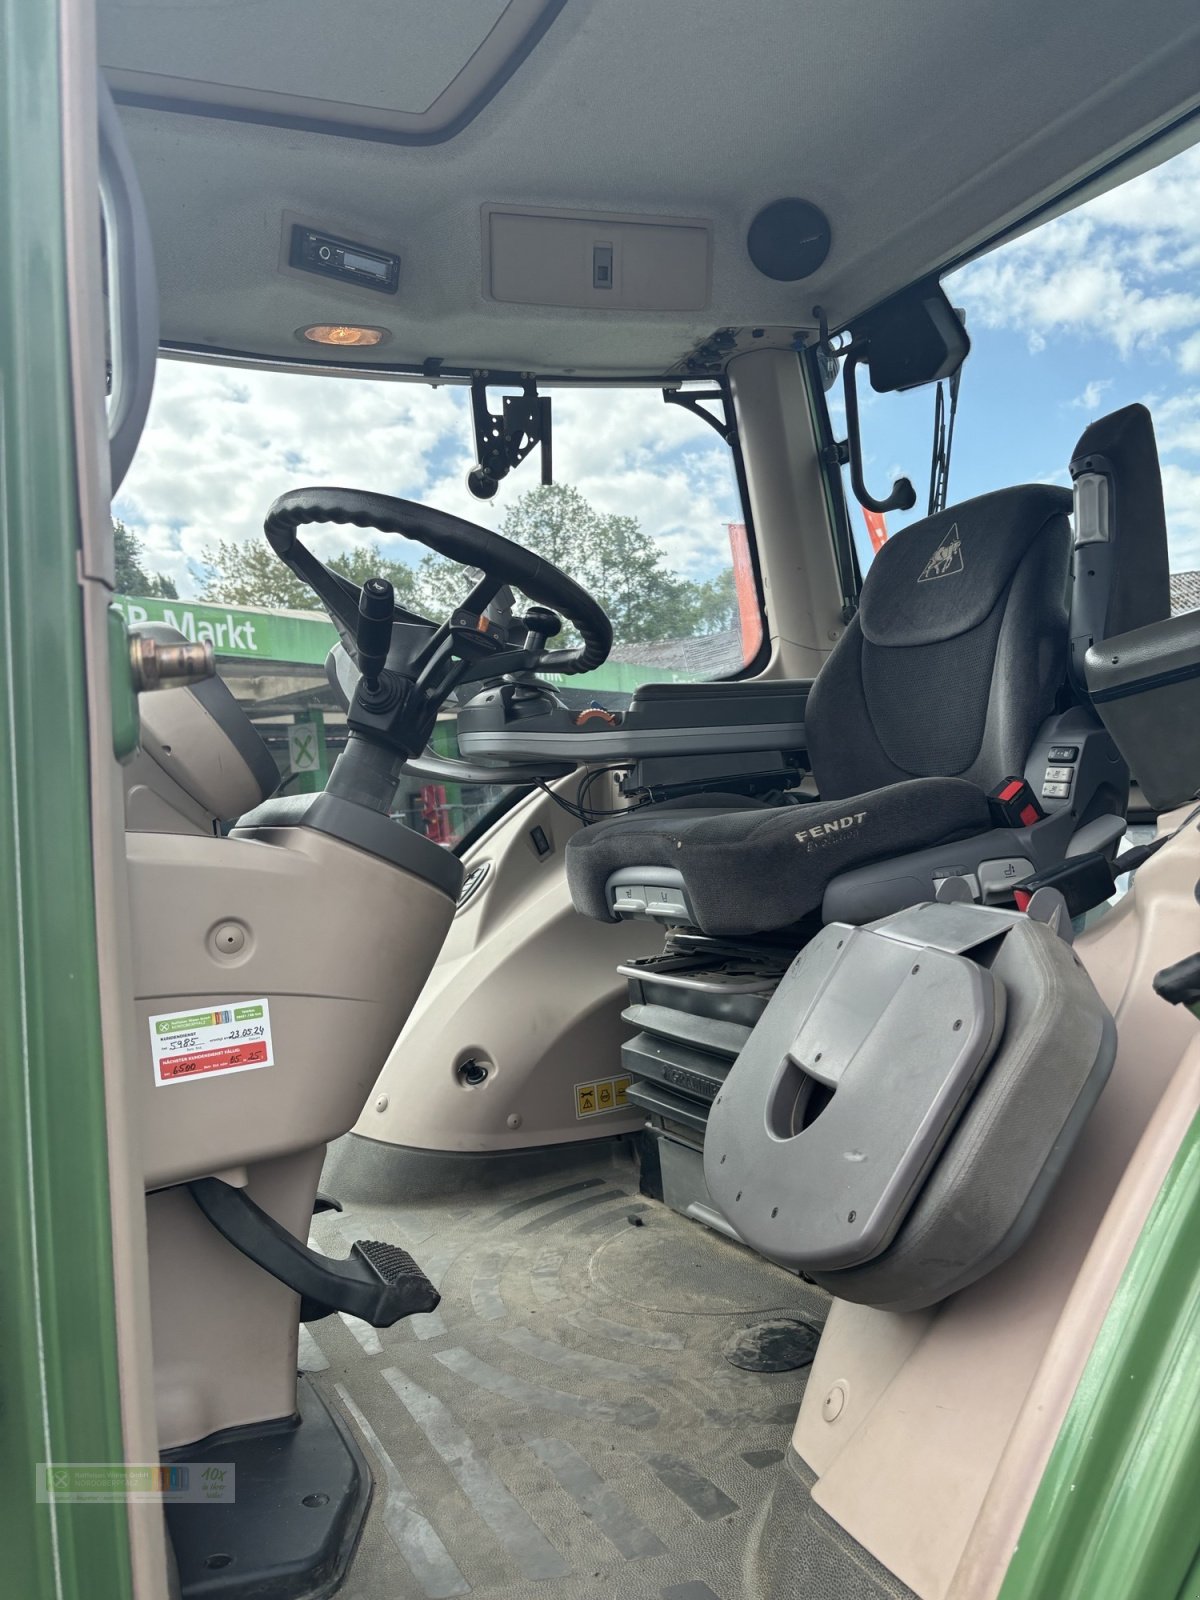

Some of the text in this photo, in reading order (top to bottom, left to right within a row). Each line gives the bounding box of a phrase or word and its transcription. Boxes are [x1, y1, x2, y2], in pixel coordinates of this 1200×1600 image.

[163, 609, 258, 650] Markt
[794, 811, 867, 842] FENDT
[169, 1037, 199, 1050] 5985
[172, 1063, 196, 1075] 6500
